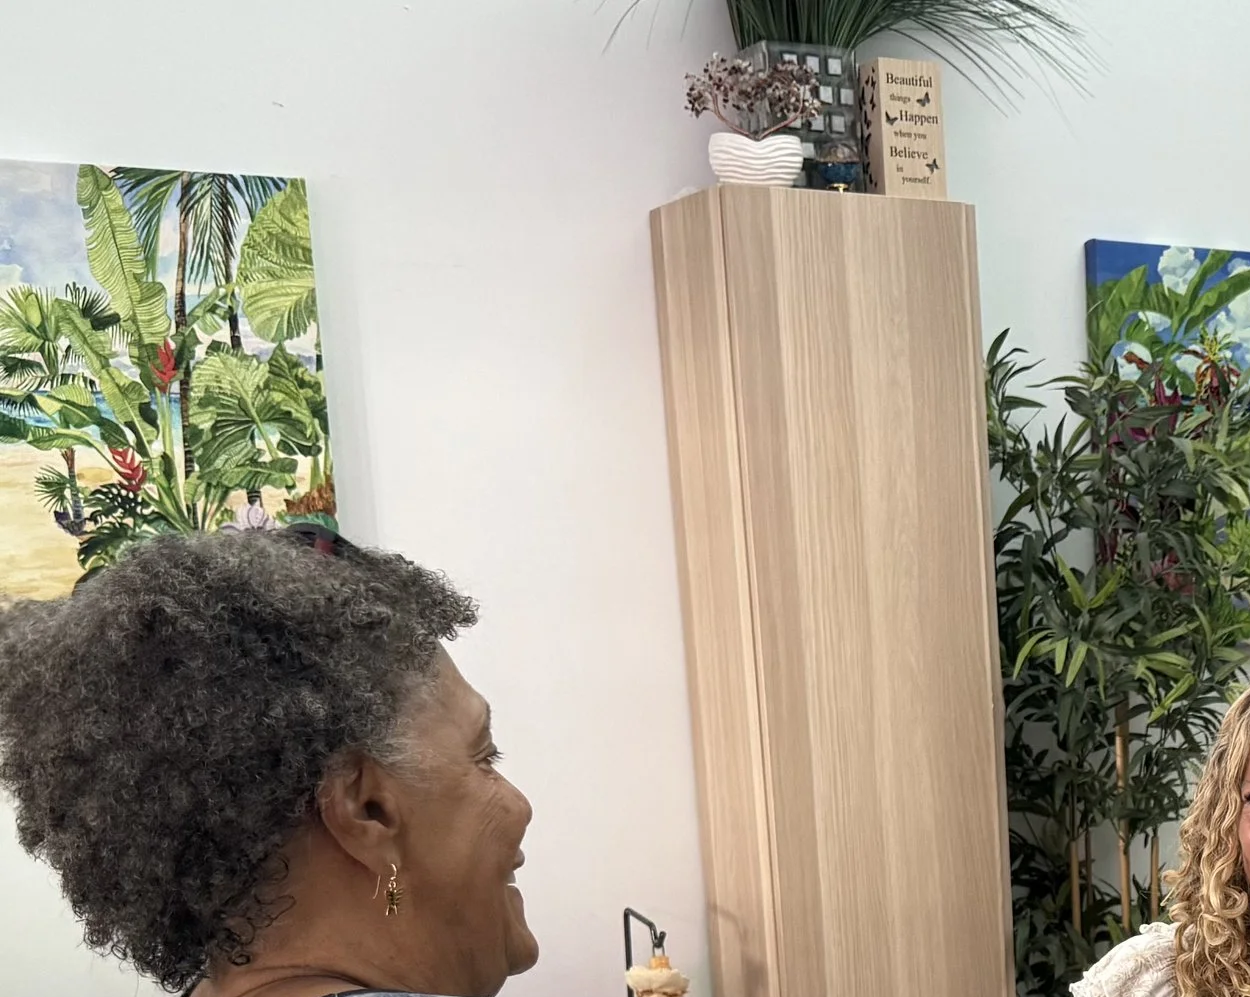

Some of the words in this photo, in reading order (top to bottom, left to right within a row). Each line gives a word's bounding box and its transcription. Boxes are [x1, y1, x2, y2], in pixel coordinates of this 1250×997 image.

[886, 72, 933, 88] Beautiful
[889, 93, 911, 104] things
[899, 109, 939, 126] Happen
[893, 130, 912, 139] when
[913, 131, 927, 141] you
[889, 145, 929, 160] Believe
